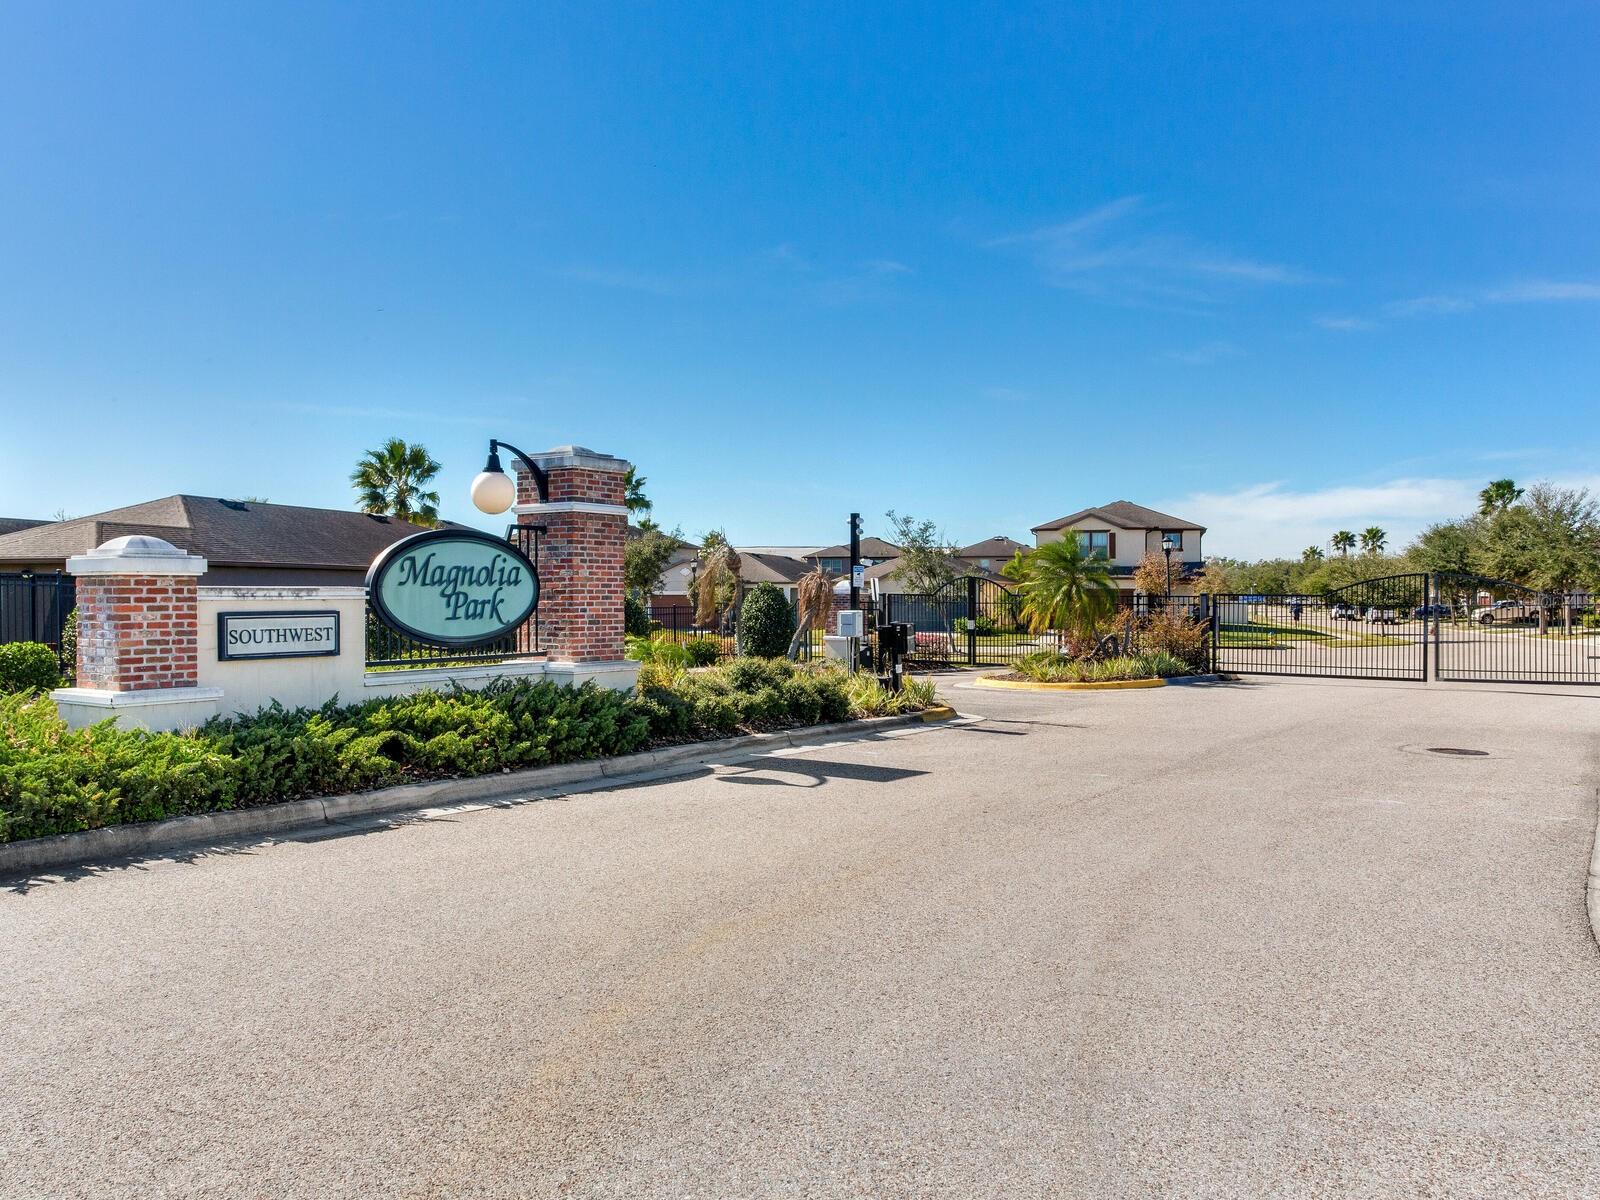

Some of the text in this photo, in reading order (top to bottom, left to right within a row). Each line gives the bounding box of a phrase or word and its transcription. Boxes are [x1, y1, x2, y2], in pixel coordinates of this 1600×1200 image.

[397, 552, 522, 597] Magnolia
[444, 587, 510, 625] Park
[228, 626, 334, 645] SOUTHWEST
